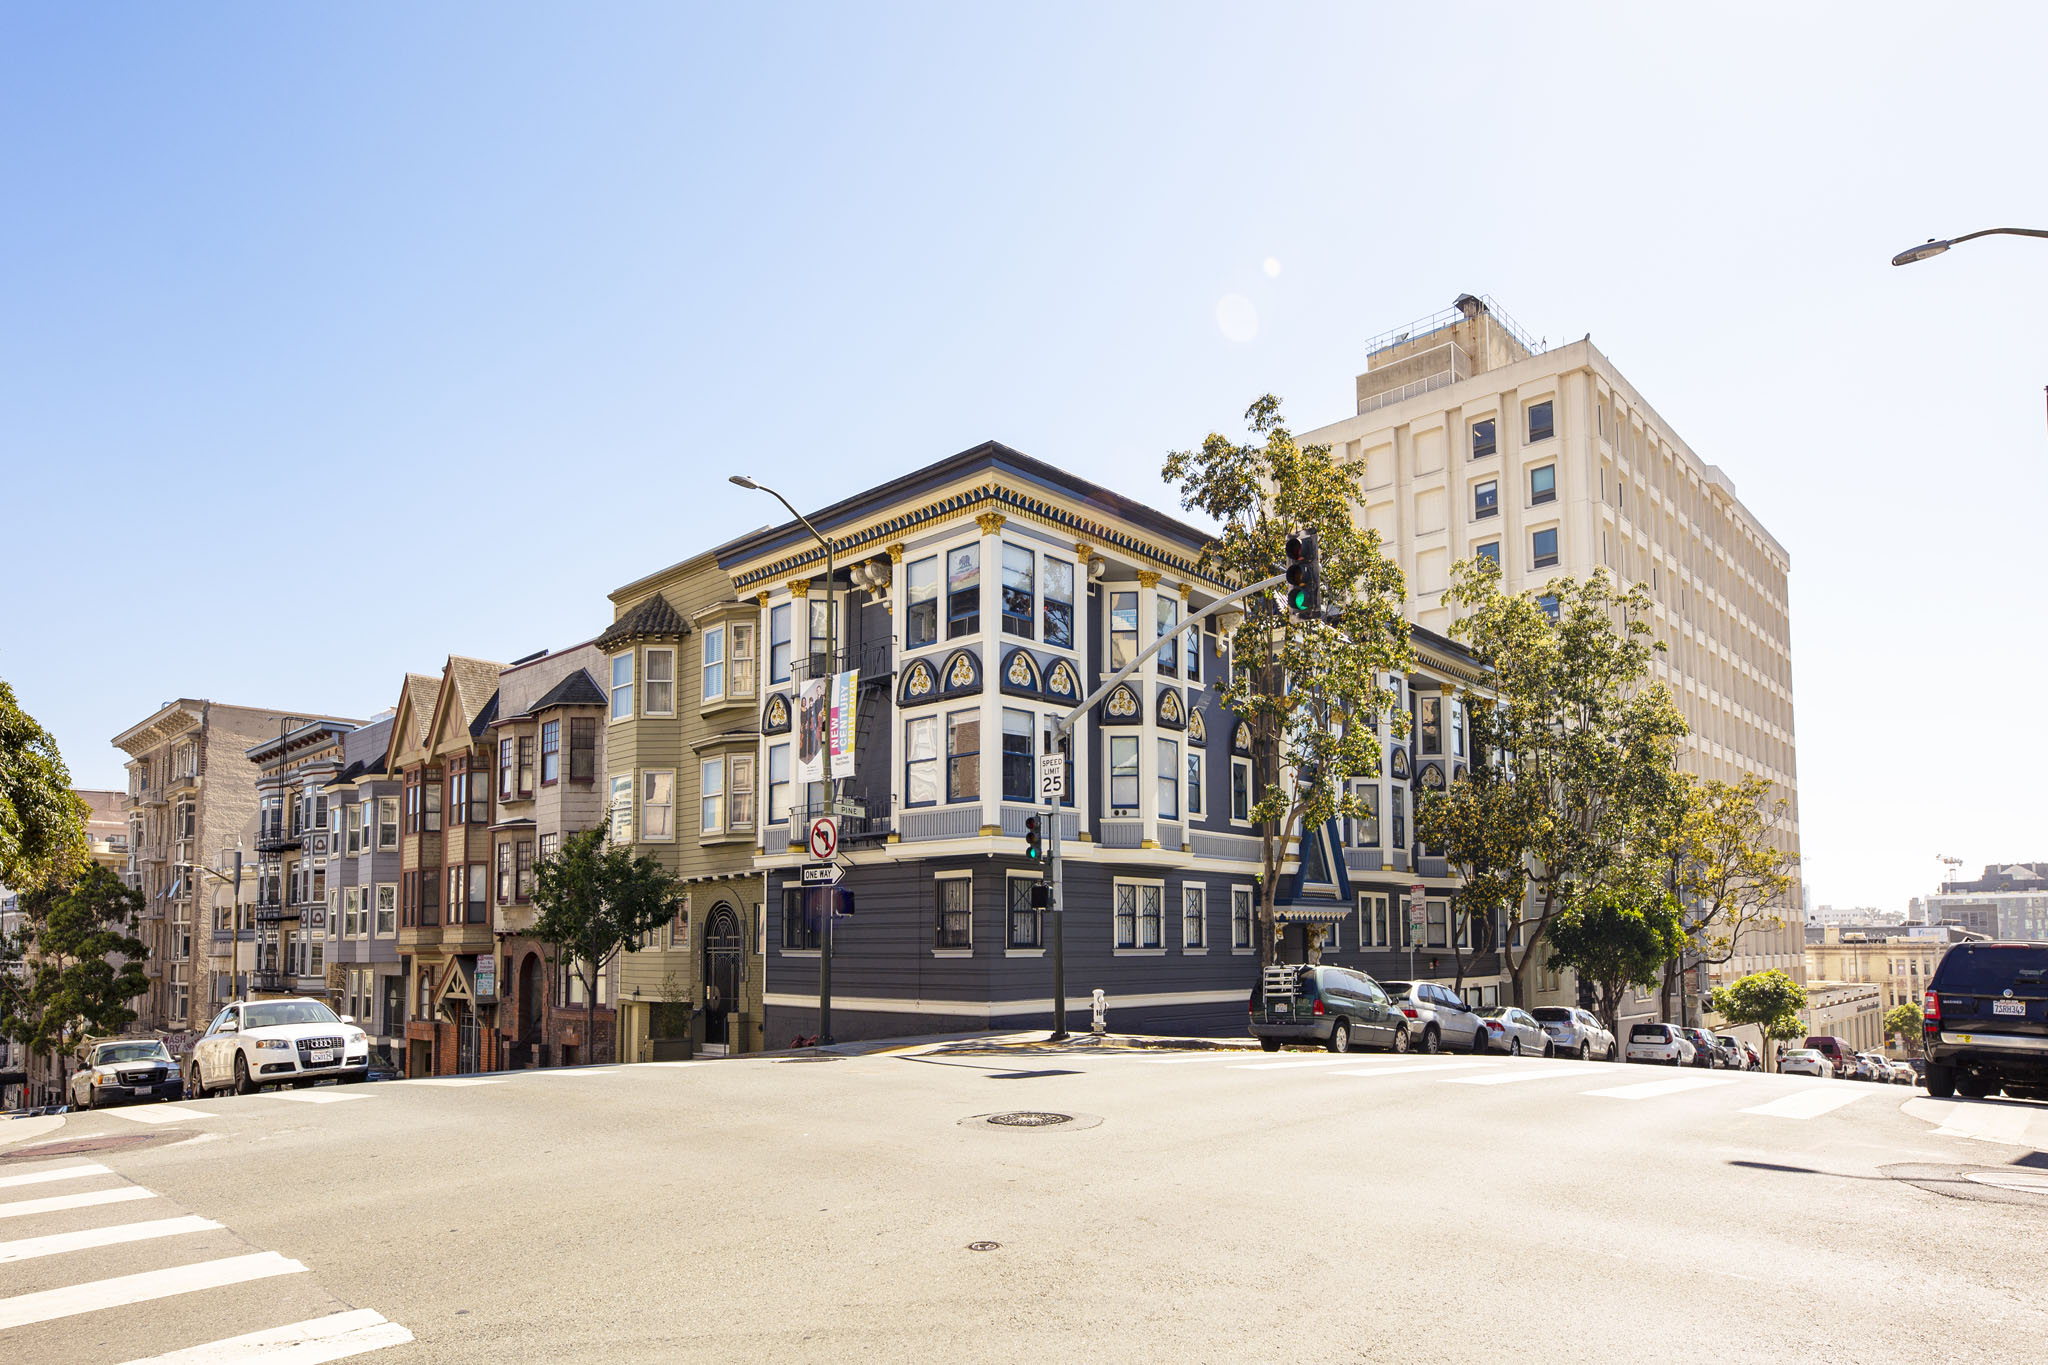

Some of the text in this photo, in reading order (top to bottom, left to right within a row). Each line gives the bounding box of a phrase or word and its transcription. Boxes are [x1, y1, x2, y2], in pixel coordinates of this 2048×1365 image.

[839, 685, 848, 747] CENTURY
[1042, 758, 1062, 766] SPEED
[1044, 767, 1060, 775] LIMIT
[1043, 776, 1061, 792] 25
[841, 806, 857, 815] PINE
[805, 869, 832, 879] ONE WAY
[163, 1035, 186, 1044] WASH
